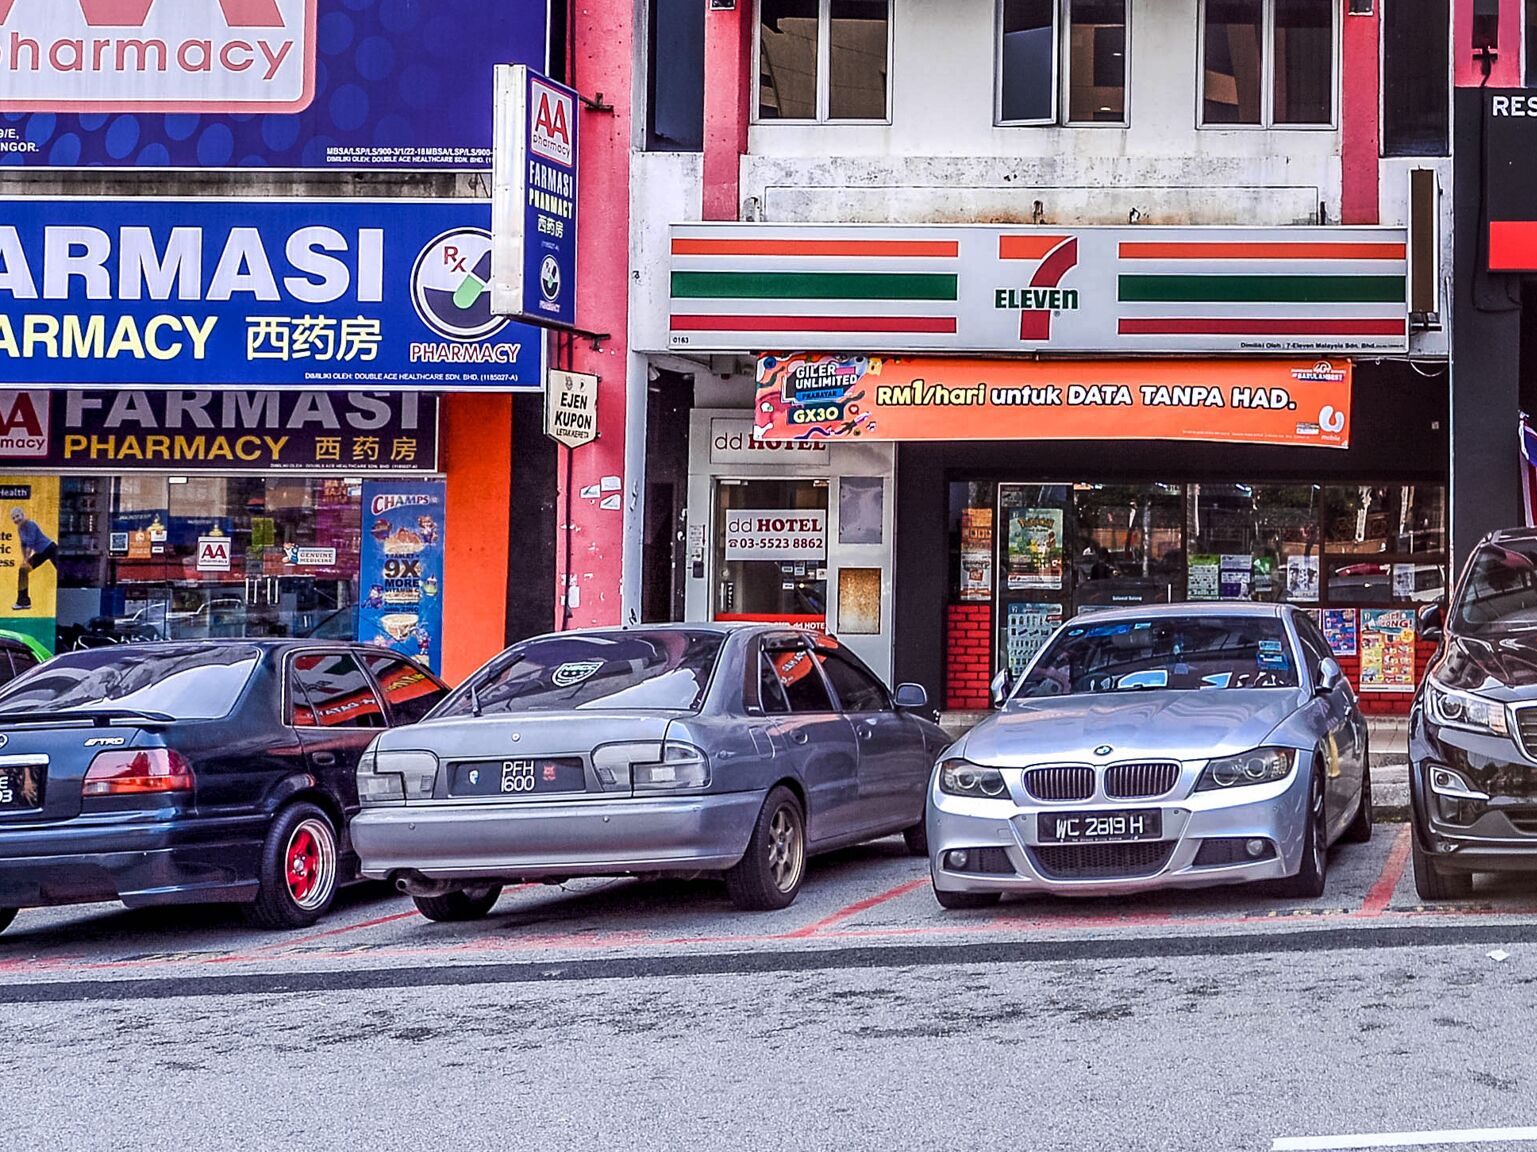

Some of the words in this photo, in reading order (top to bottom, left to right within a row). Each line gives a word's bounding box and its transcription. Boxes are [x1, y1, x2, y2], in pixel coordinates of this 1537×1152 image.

[0, 32, 293, 80] harmacy
[535, 93, 569, 145] AA
[0, 142, 40, 152] NGOR.
[533, 134, 570, 158] pharmacy
[529, 160, 573, 198] FARMASI
[0, 226, 384, 302] ARMASI
[246, 315, 382, 362] 西药房
[410, 343, 521, 363] PHARMACY
[796, 364, 836, 379] GILER
[795, 375, 858, 390] UNLIMITED
[560, 392, 588, 410] EJEN
[875, 378, 987, 406] RM1/hari
[990, 386, 1062, 408] untuk
[1066, 385, 1134, 408] DATA
[1139, 385, 1224, 408] TANPA
[1231, 386, 1297, 410] HAD.
[65, 391, 418, 430] FARMASI
[554, 410, 592, 430] KUPON
[0, 438, 45, 451] macy
[64, 435, 288, 461] PHARMACY
[315, 436, 418, 461] 西药房
[714, 432, 742, 450] dd
[371, 494, 430, 515] CHAMPS
[729, 517, 753, 532] dd
[757, 518, 822, 532] HOTEL
[201, 544, 227, 560] AA
[740, 538, 790, 549] 03-5523
[793, 538, 823, 549] 8862
[384, 560, 420, 578] 9X
[384, 579, 420, 587] MORE
[502, 760, 535, 776] PFH
[501, 775, 535, 792] 1600
[1056, 817, 1079, 839] WC
[1085, 817, 1126, 836] 2819
[1130, 816, 1143, 834] H
